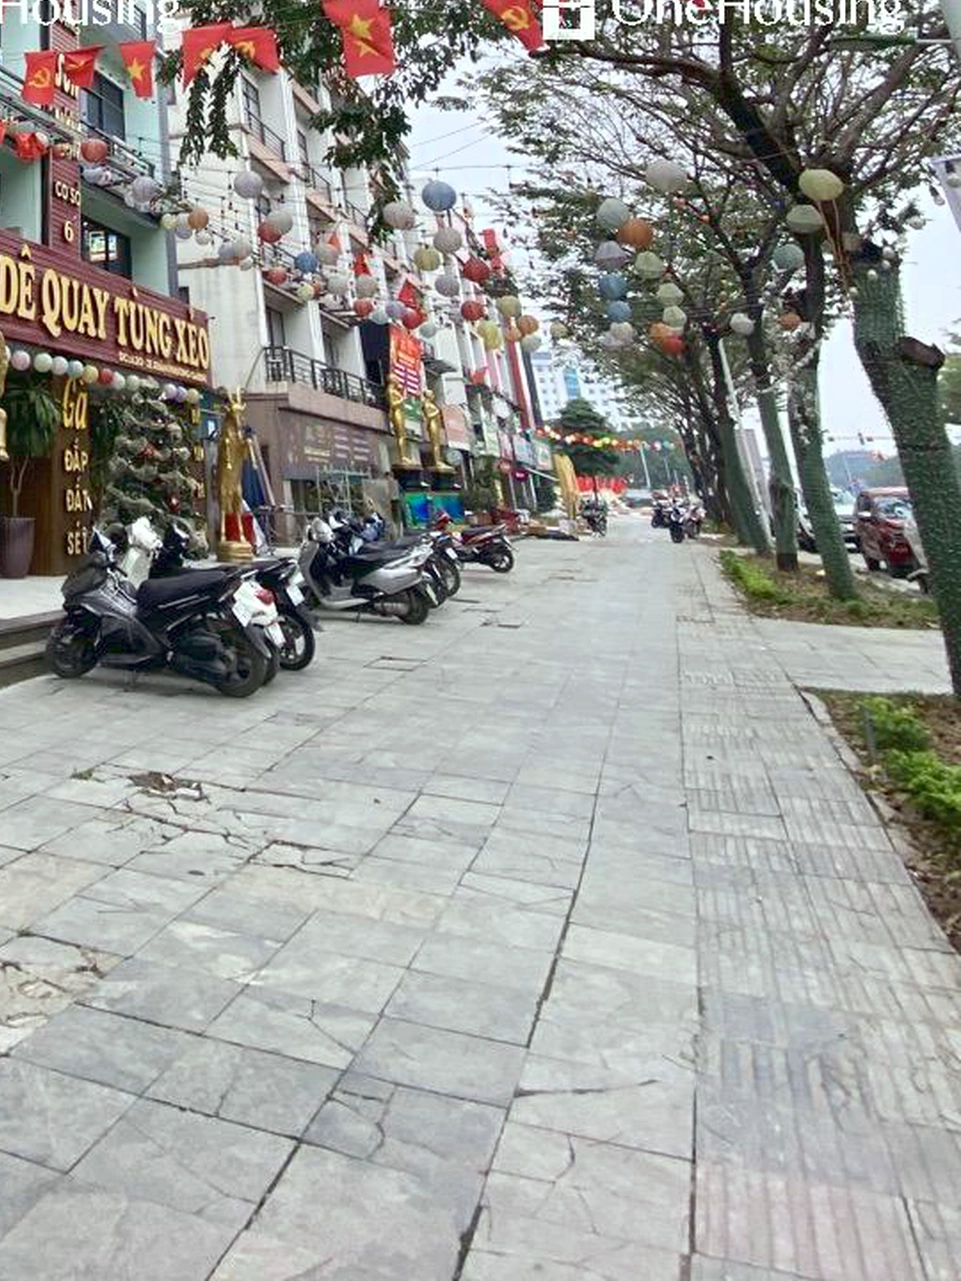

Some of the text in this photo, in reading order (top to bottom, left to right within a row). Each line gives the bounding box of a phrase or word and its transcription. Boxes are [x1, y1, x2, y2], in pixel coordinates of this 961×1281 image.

[64, 220, 75, 243] 6
[41, 267, 110, 340] QUAY
[114, 285, 172, 358] TÙNG
